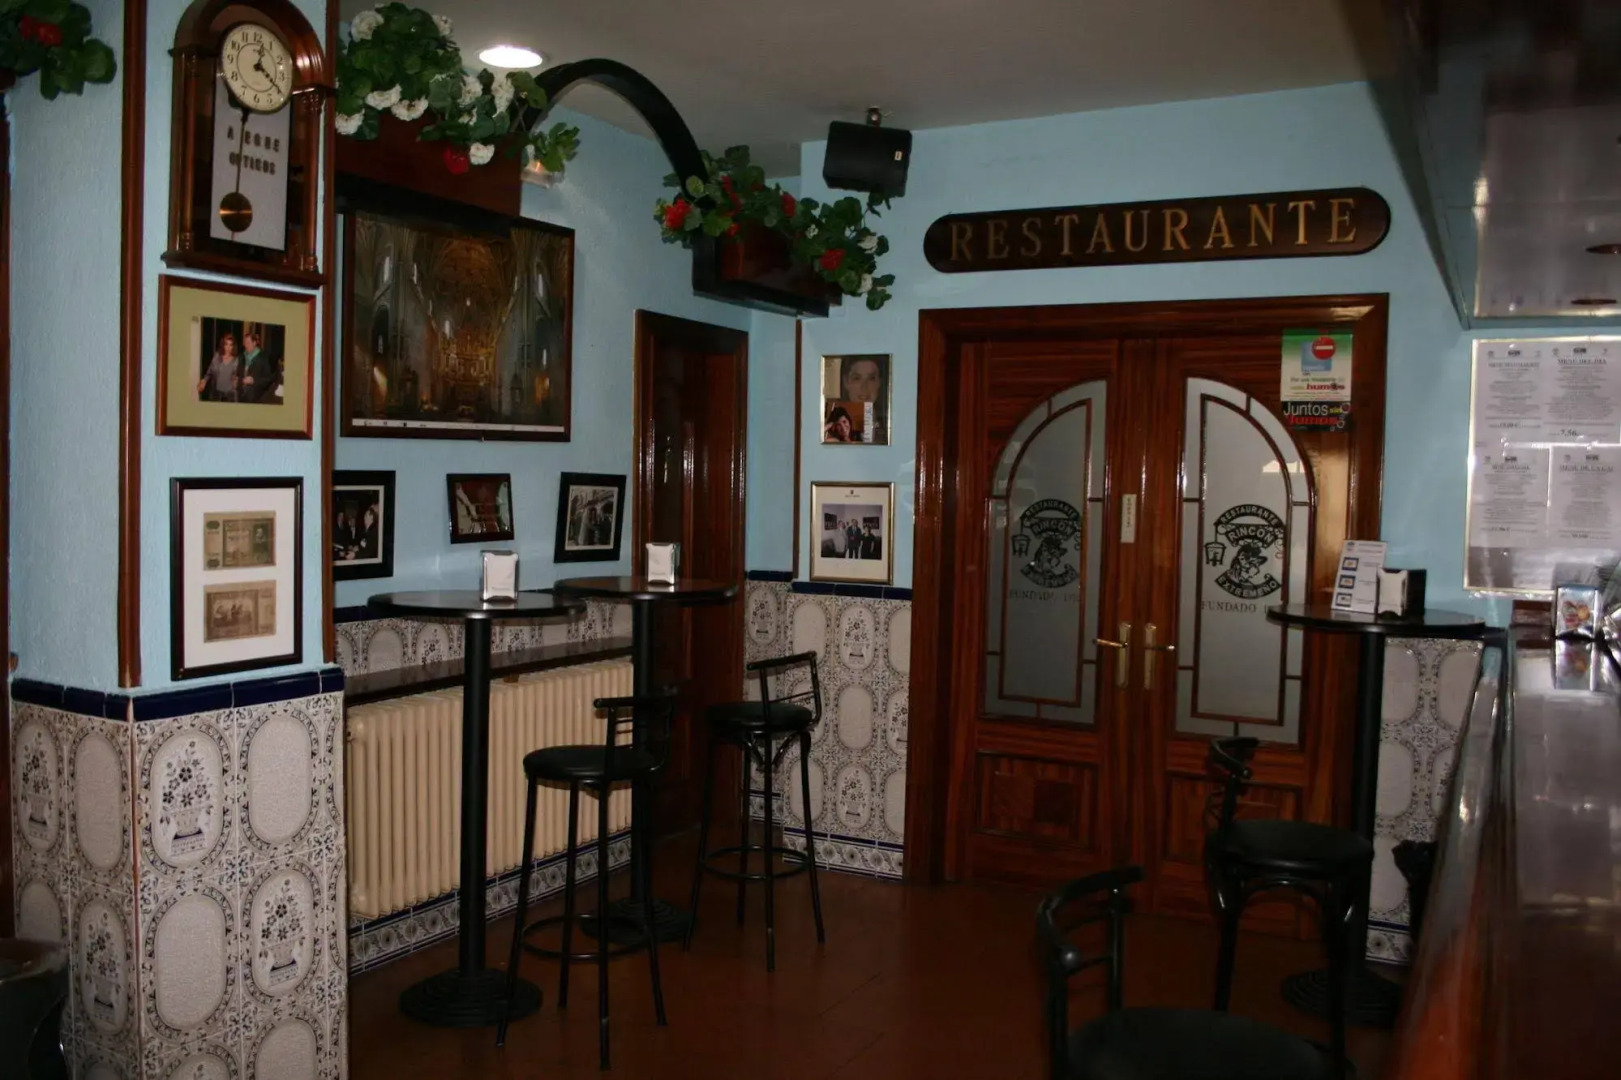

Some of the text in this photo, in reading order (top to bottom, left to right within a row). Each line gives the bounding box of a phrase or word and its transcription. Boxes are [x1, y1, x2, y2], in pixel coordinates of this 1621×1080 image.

[241, 31, 249, 42] 11
[253, 31, 263, 43] 12
[231, 39, 241, 51] 10
[269, 41, 273, 51] 1
[226, 54, 234, 64] 9
[276, 55, 284, 66] 2
[230, 70, 239, 82] 8
[278, 71, 285, 82] 3
[240, 84, 248, 96] 7
[253, 93, 260, 104] 6
[949, 197, 1358, 261] RESTAURANTE
[1283, 401, 1328, 416] Juntos
[1219, 504, 1280, 525] RESTAURANTE
[1200, 600, 1257, 613] FUNDADO
